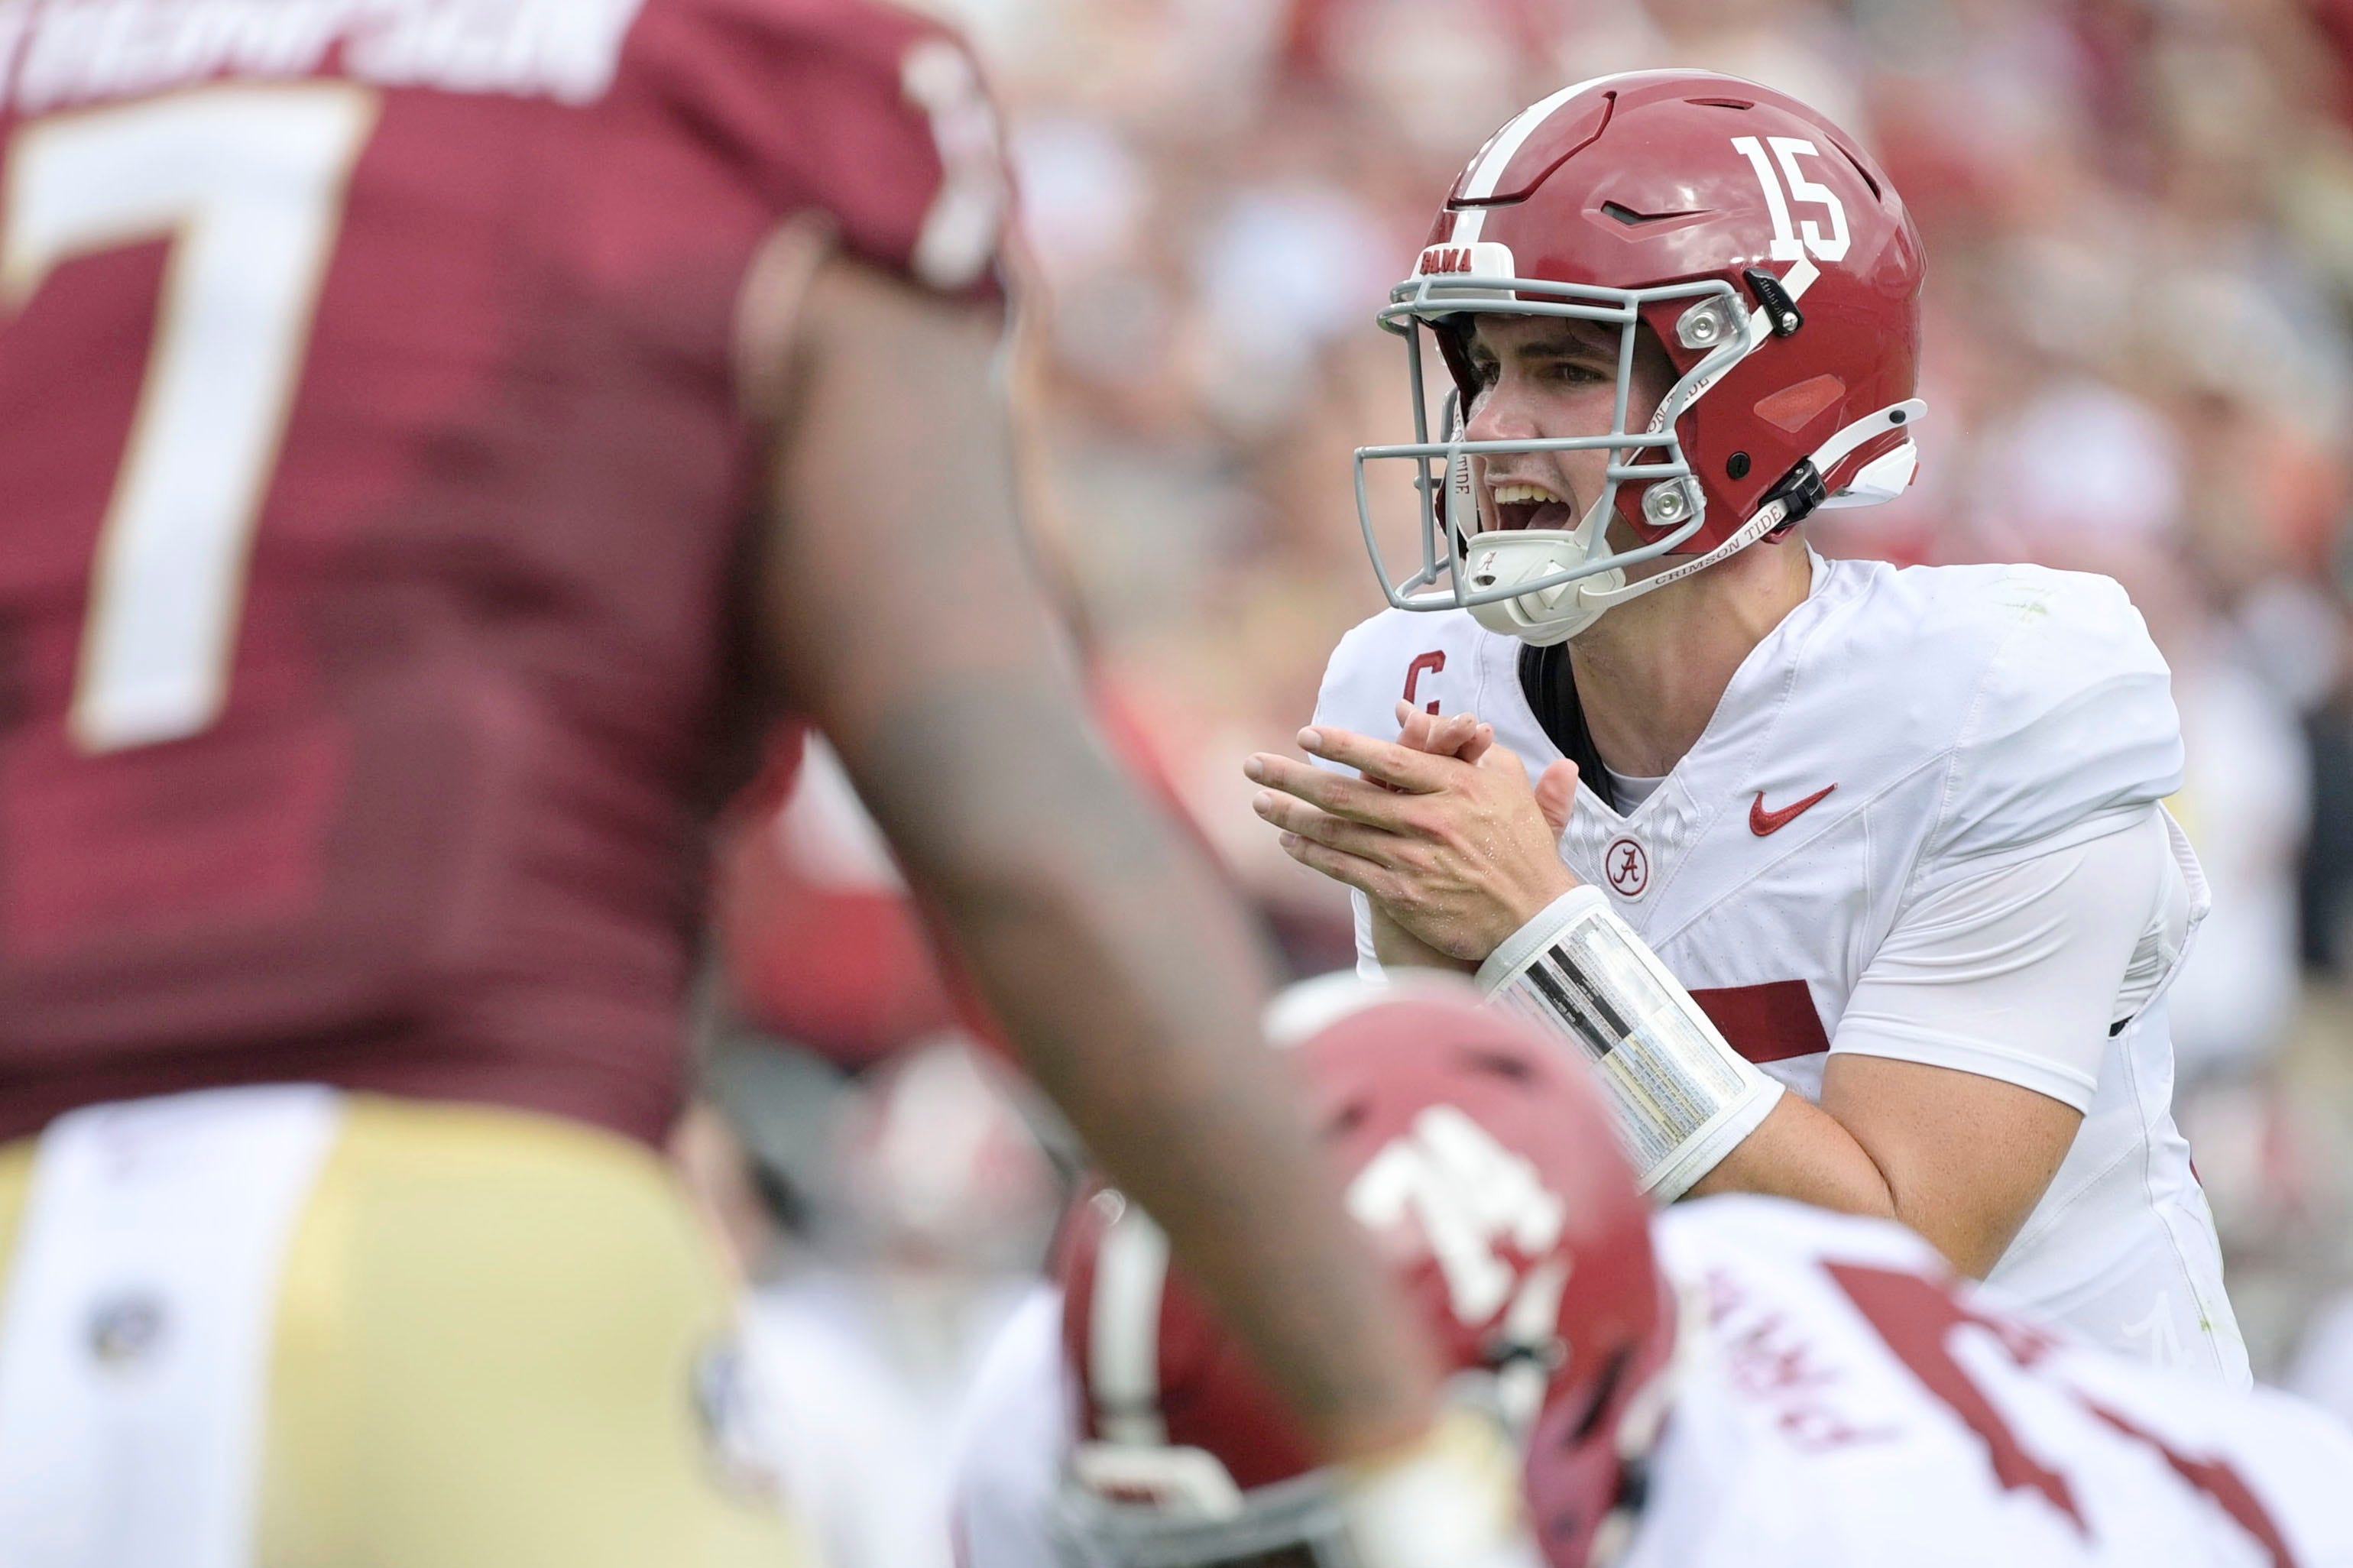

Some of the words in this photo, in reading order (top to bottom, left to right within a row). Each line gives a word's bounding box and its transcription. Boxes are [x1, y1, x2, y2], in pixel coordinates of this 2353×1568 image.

[1730, 136, 1851, 261] 15
[0, 75, 386, 756] 7
[1655, 538, 1741, 585] CRIMSON
[1744, 505, 1782, 541] TIDE
